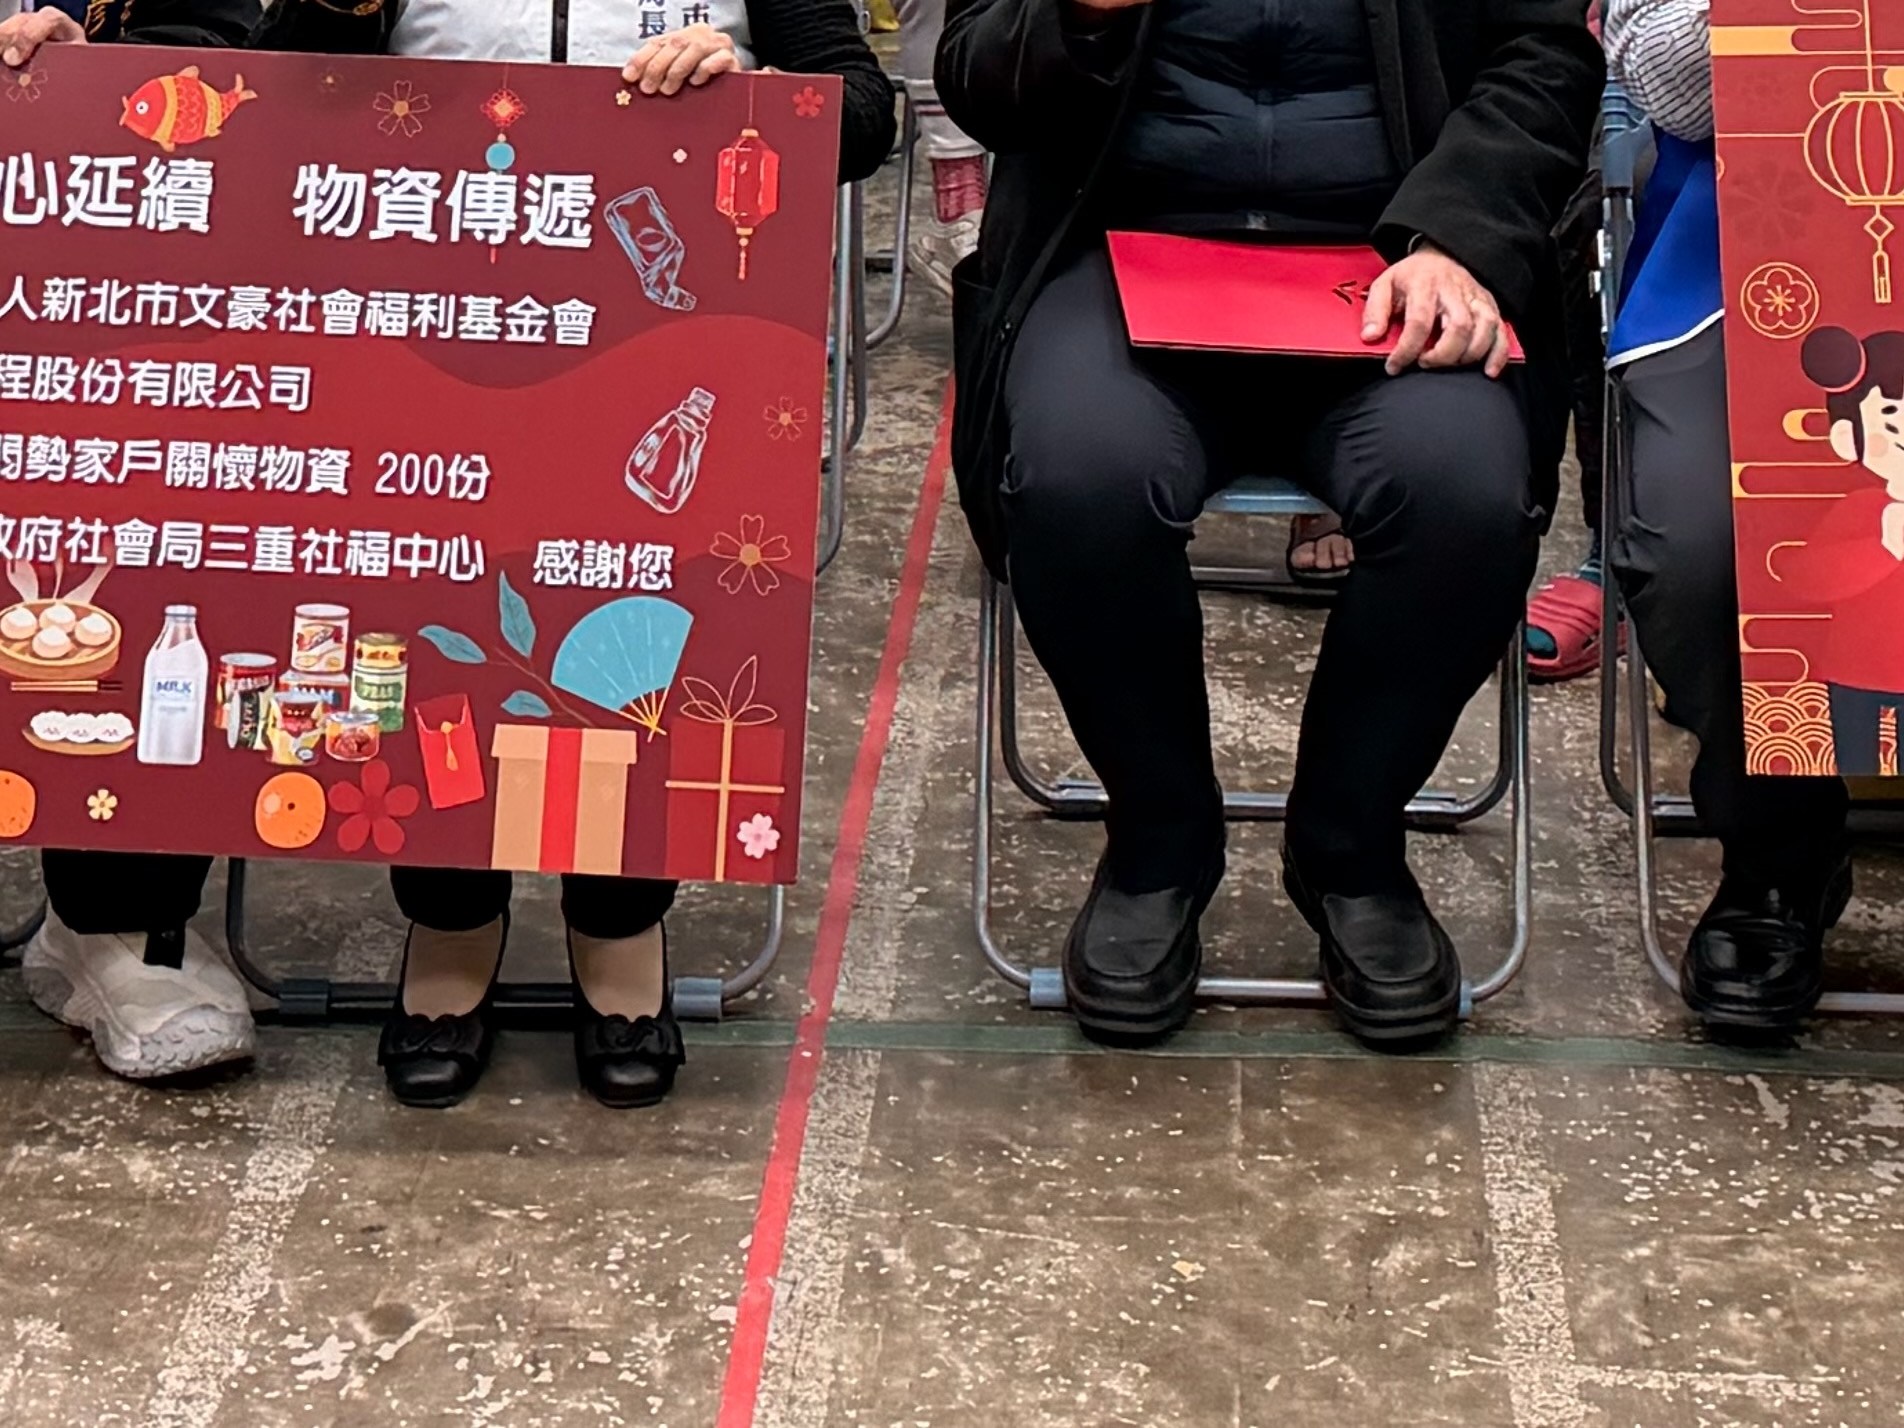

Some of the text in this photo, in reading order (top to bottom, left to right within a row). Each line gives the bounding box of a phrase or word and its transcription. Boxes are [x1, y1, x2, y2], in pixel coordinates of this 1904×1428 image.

[292, 165, 597, 248] 物資傳遞
[375, 451, 491, 501] 200份
[533, 540, 674, 591] 感謝您
[156, 680, 192, 694] MILK
